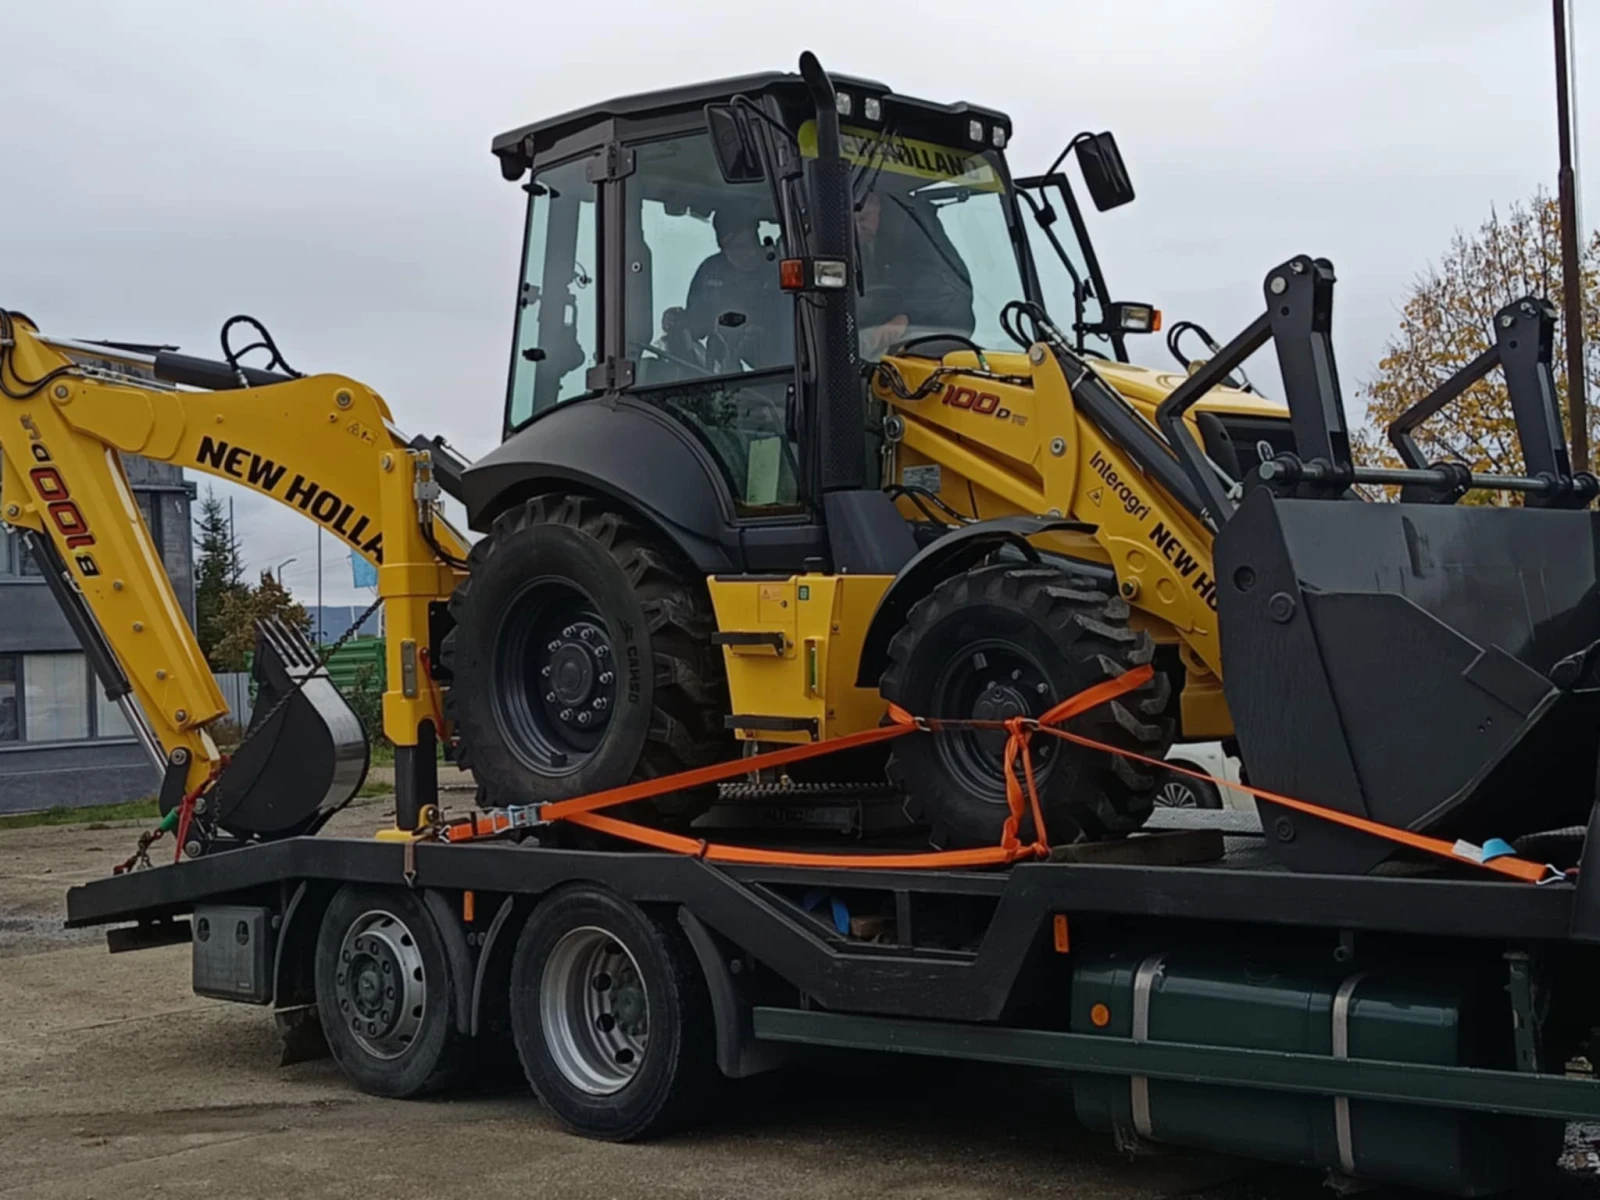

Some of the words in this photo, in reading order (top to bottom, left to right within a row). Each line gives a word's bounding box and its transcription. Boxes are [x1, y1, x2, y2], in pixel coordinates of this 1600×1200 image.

[196, 435, 287, 492] NEW
[284, 474, 384, 566] HOLLA
[1089, 450, 1151, 522] Interagri
[1149, 521, 1199, 578] NEW
